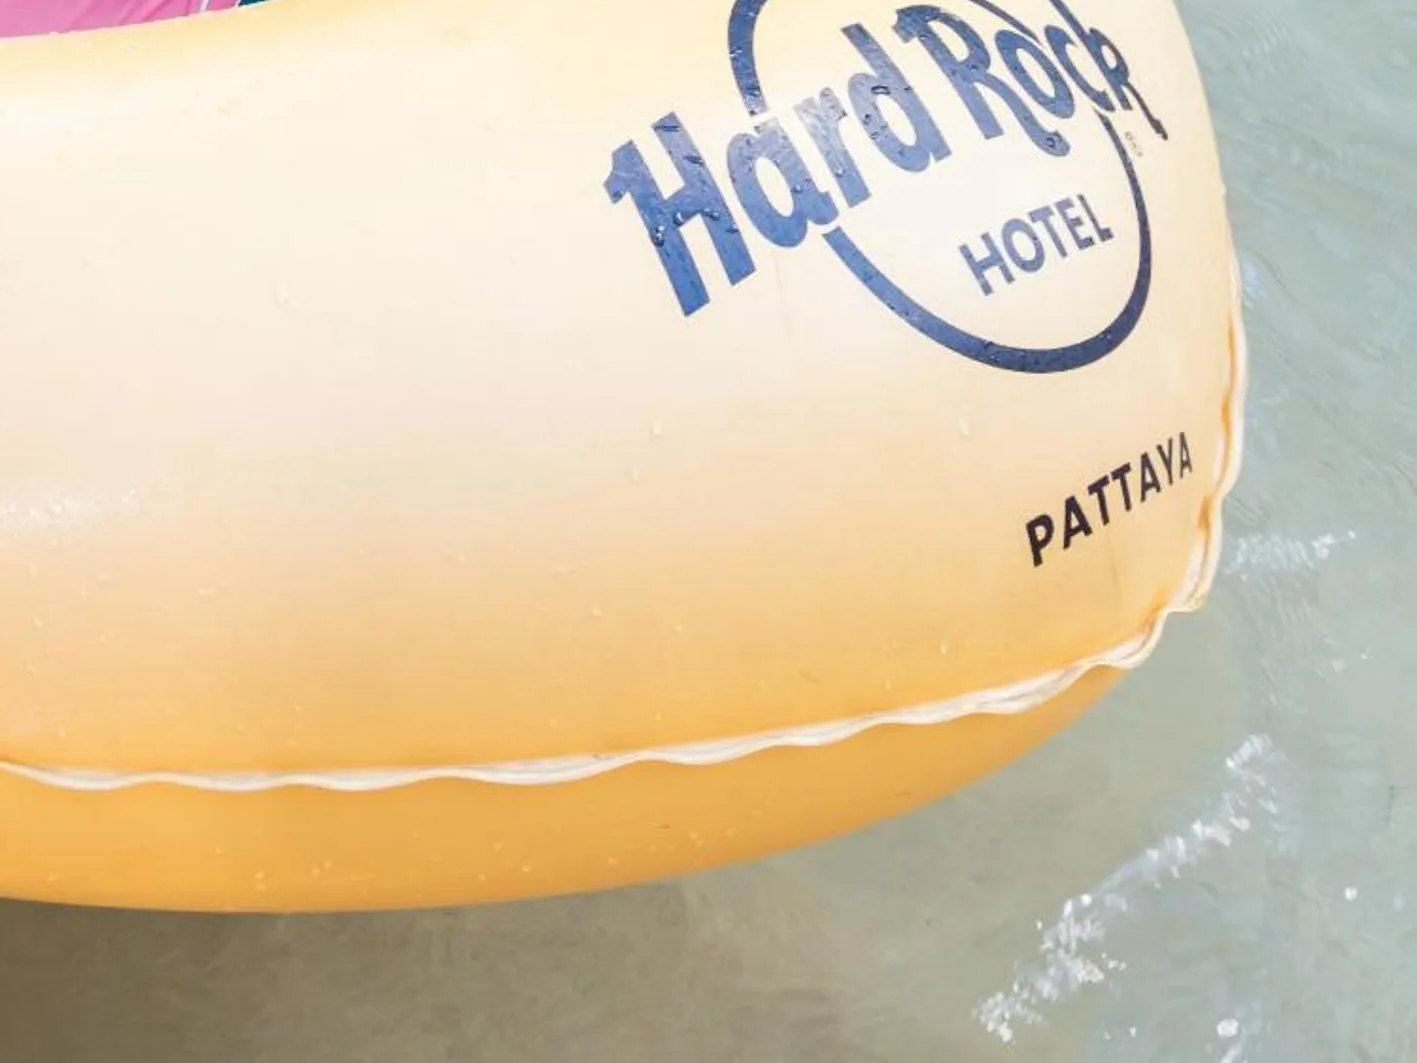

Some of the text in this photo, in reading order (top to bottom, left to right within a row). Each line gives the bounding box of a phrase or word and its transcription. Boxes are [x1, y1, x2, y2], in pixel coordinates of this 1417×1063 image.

[603, 22, 953, 317] Hard
[958, 193, 1115, 297] HOTEL
[1025, 431, 1193, 568] PATTAYA
